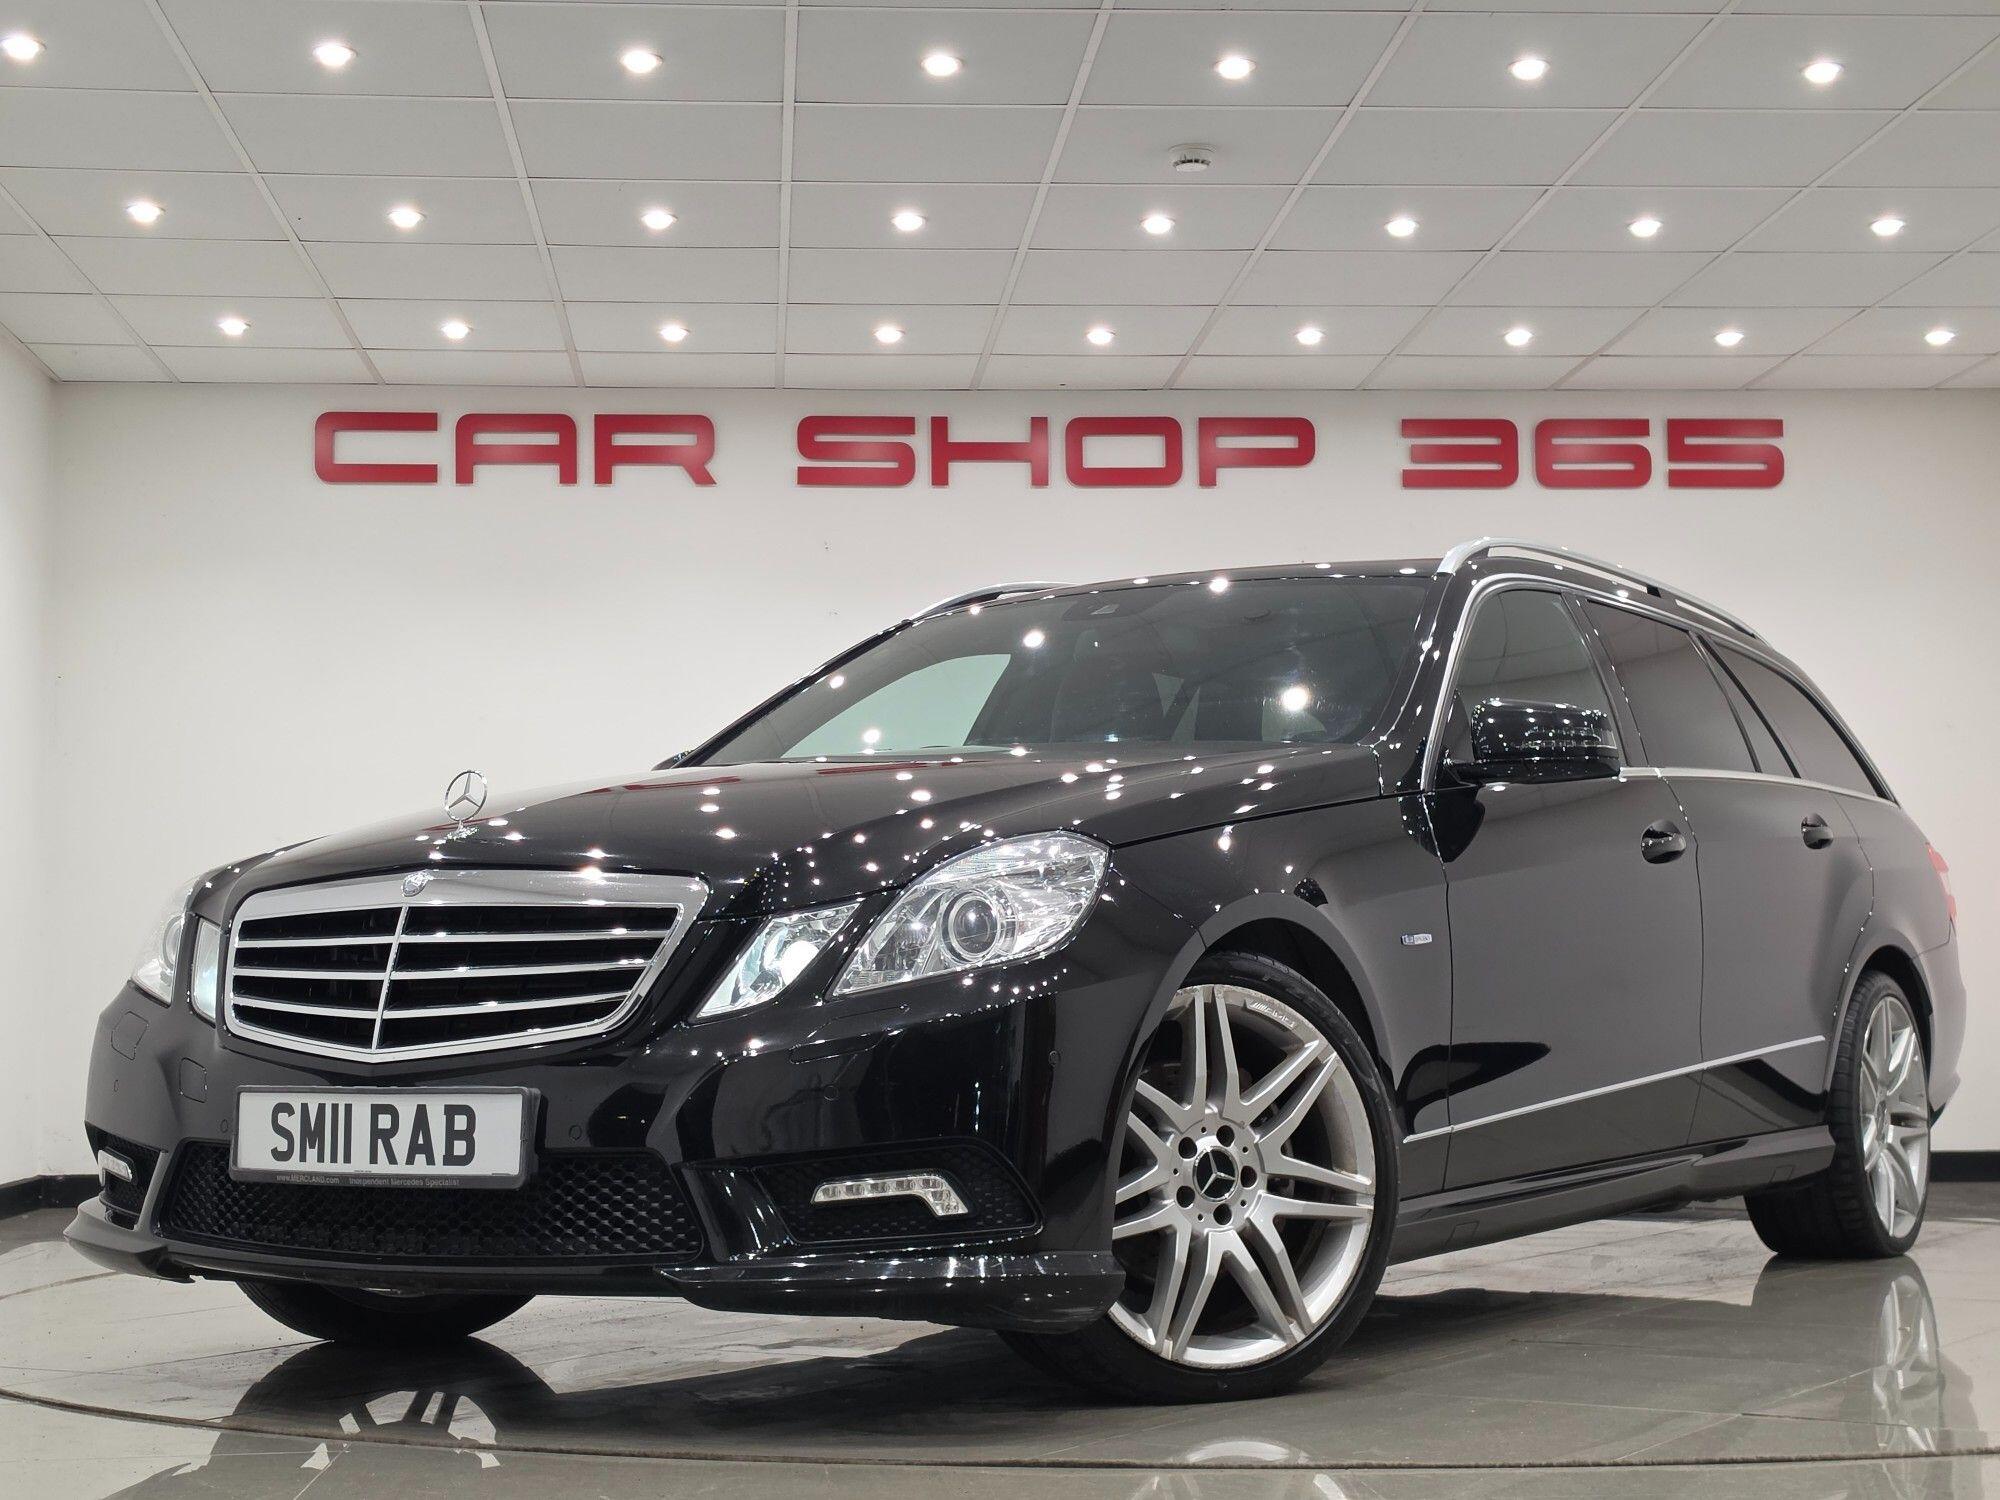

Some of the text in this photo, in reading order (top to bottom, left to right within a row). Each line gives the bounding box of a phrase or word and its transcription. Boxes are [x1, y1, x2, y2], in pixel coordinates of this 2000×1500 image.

[314, 411, 1785, 488] CAR SHOP 365
[369, 1103, 477, 1167] RAB
